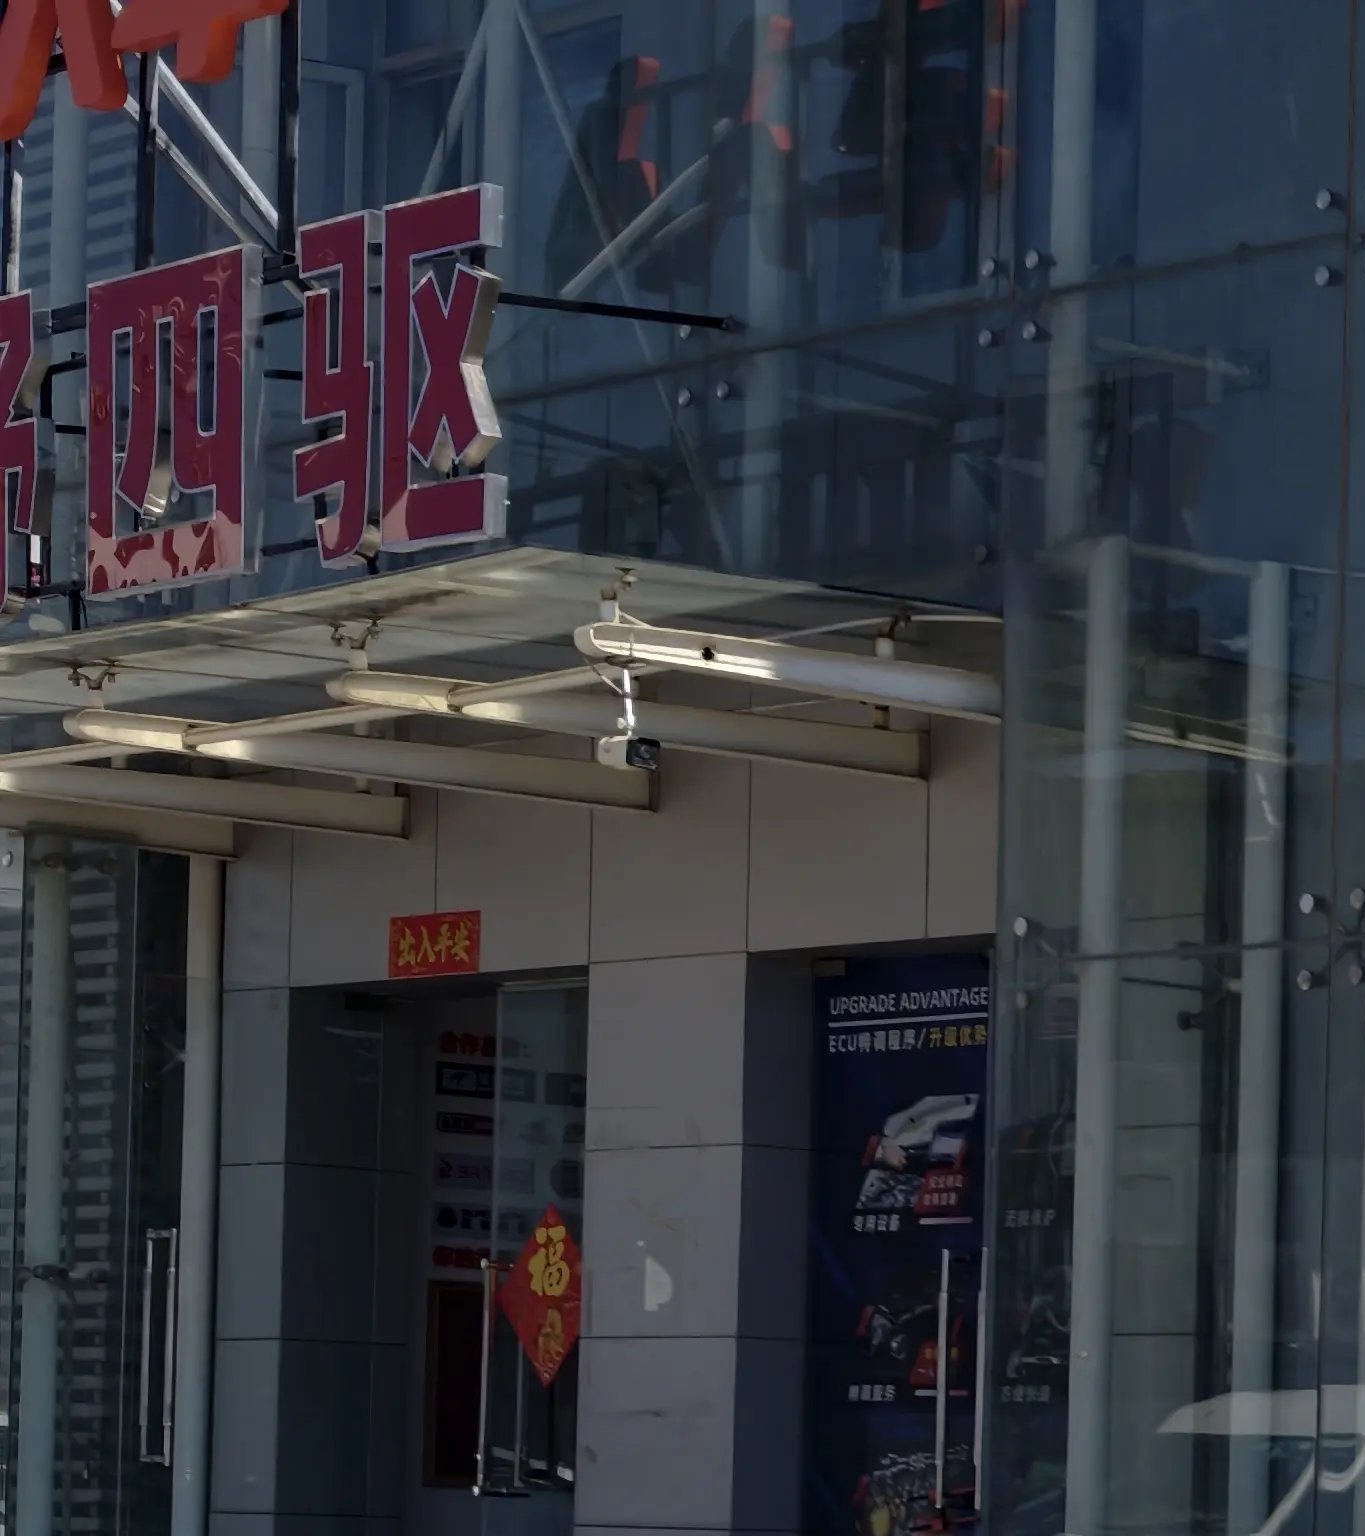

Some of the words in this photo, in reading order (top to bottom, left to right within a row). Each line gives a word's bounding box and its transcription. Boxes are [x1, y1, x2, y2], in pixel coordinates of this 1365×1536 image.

[0, 183, 506, 606] 四驱
[397, 920, 471, 967] 出入平安
[829, 993, 896, 1016] UPGRADE
[899, 986, 989, 1012] ADVANTAGE
[528, 1225, 571, 1297] 福
